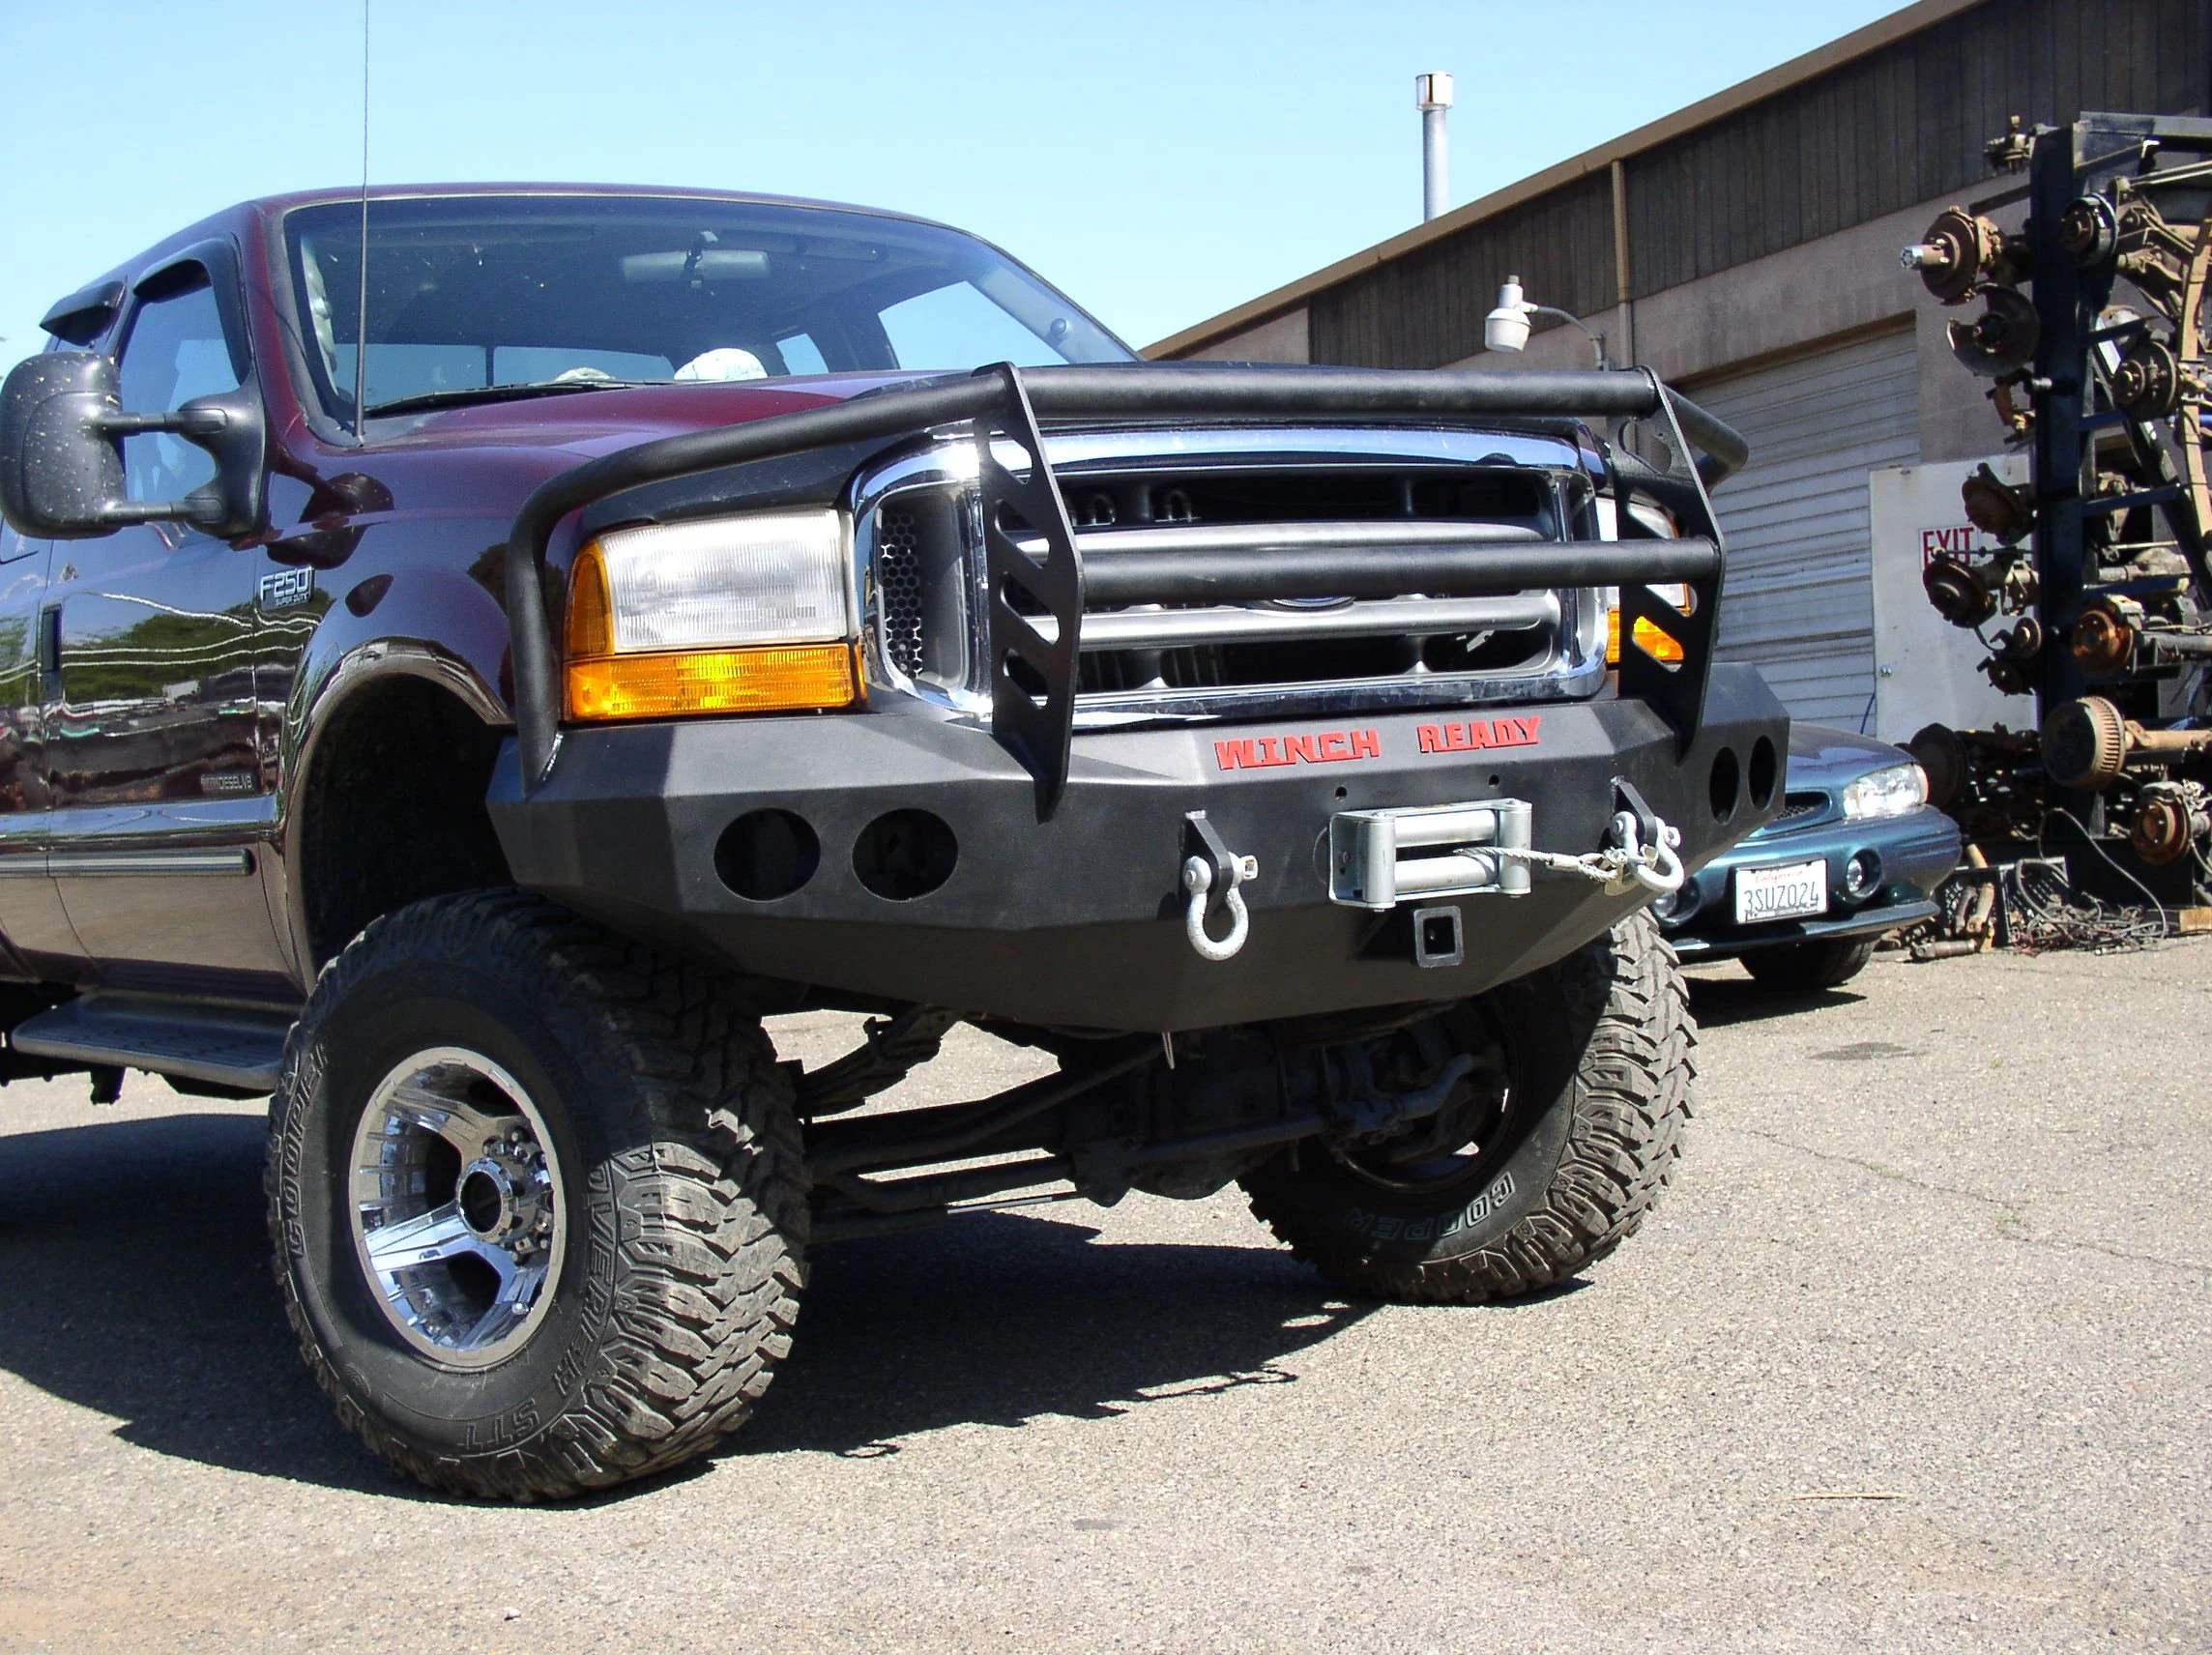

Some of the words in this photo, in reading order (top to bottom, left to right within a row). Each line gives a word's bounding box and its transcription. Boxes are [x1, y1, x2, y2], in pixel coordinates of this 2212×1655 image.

[1922, 527, 1974, 569] EXIT
[260, 568, 309, 601] F250
[1214, 728, 1382, 770] WINCH
[1415, 715, 1543, 754] READY
